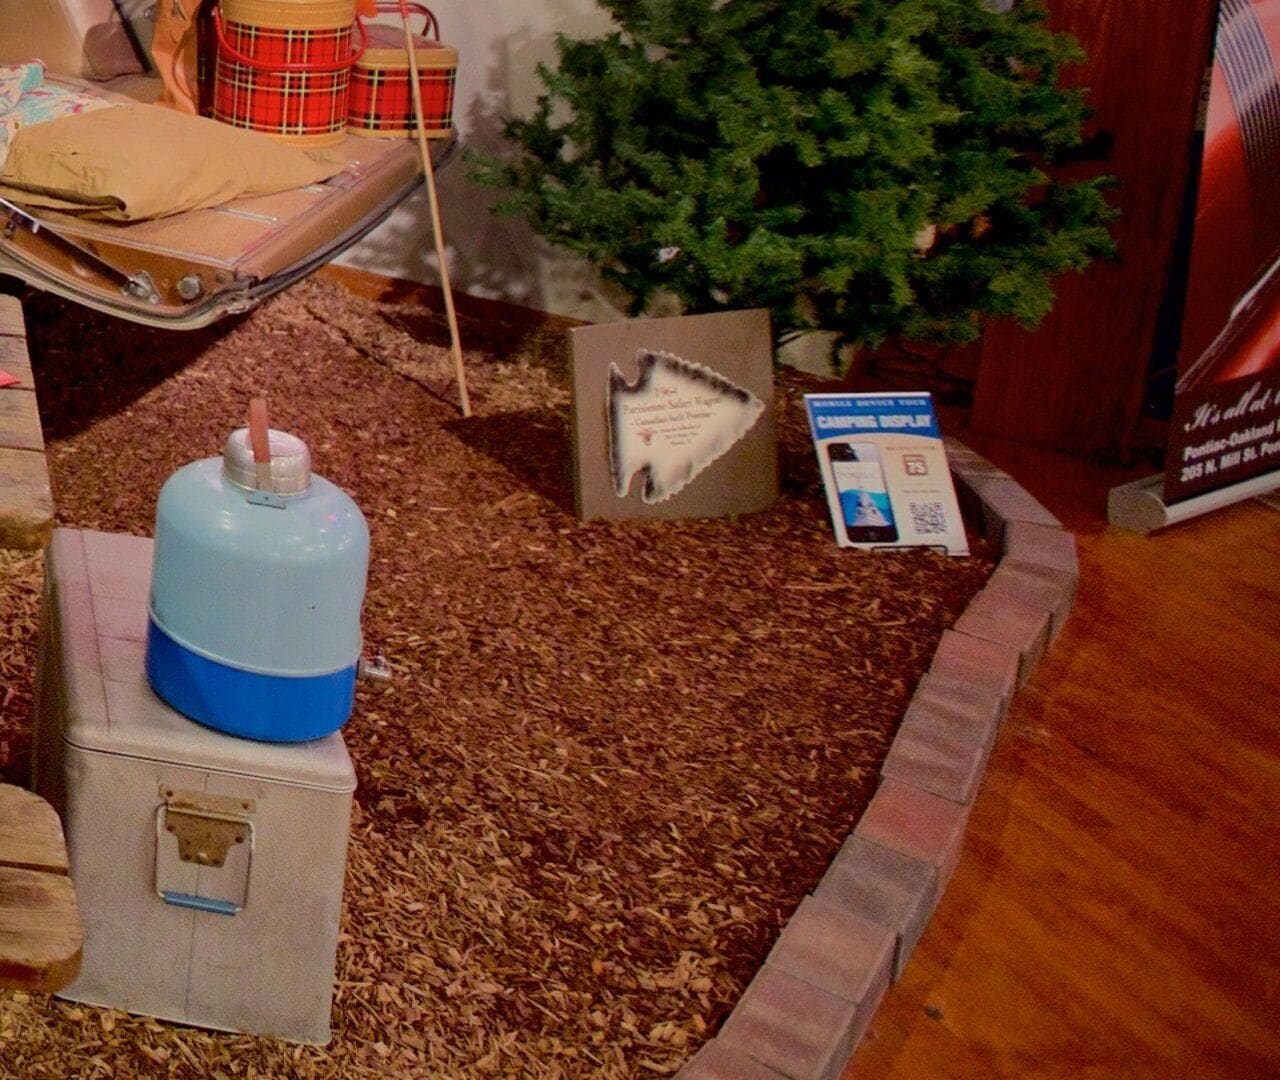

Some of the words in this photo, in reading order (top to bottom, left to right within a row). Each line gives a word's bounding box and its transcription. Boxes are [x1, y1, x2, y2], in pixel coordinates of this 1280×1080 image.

[1223, 381, 1262, 420] all
[1249, 388, 1272, 412] at
[879, 414, 931, 428] DISPLAY
[1183, 421, 1275, 461] Pontiac-Oakland
[1180, 463, 1203, 482] 205
[1220, 451, 1240, 469] Mill
